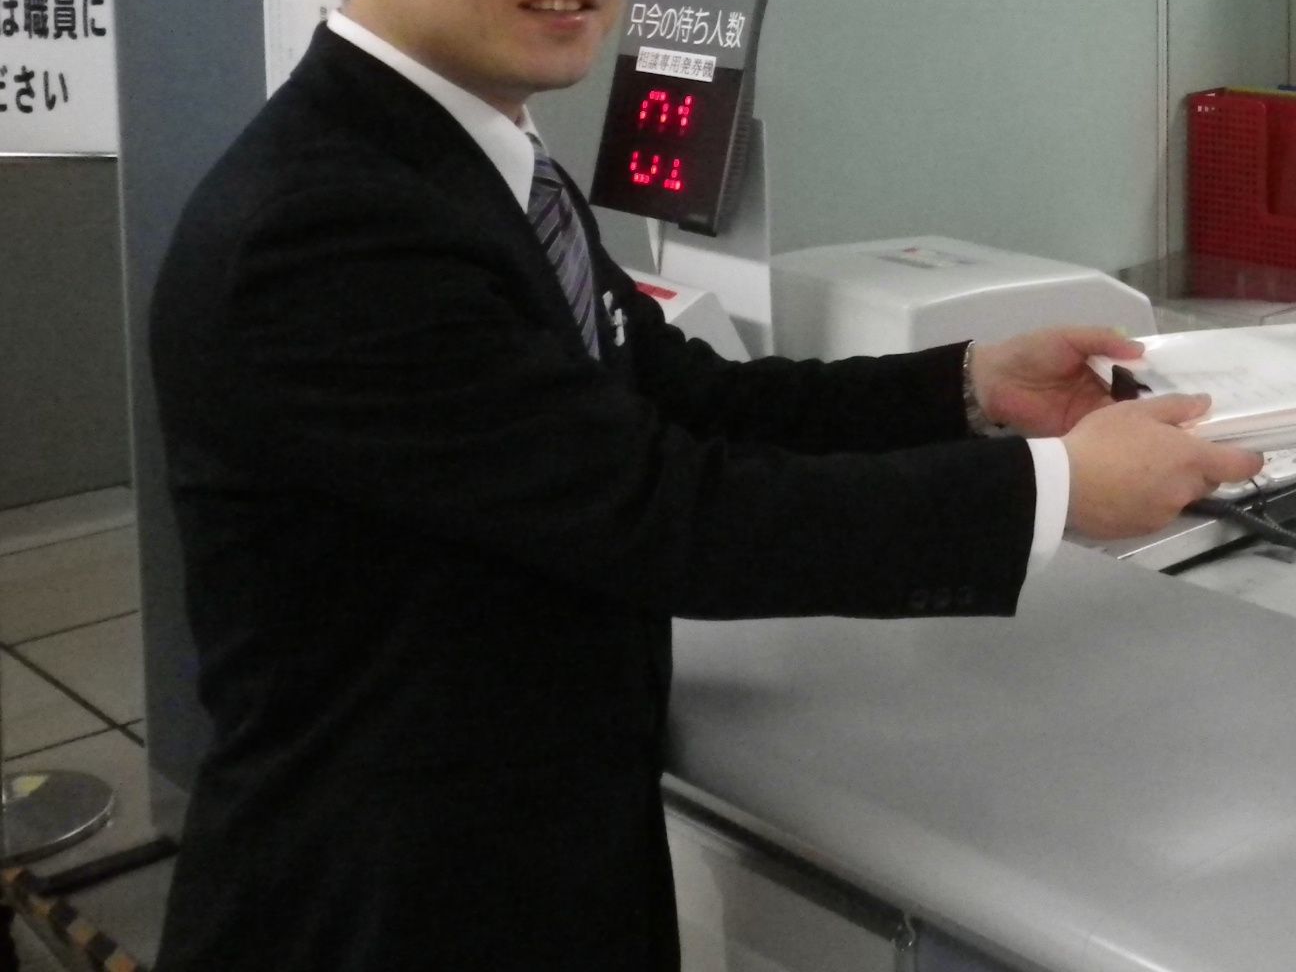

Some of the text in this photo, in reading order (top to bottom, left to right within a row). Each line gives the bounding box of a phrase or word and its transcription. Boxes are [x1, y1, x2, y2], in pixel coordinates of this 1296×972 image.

[627, 3, 746, 49] 只今の待ち人数
